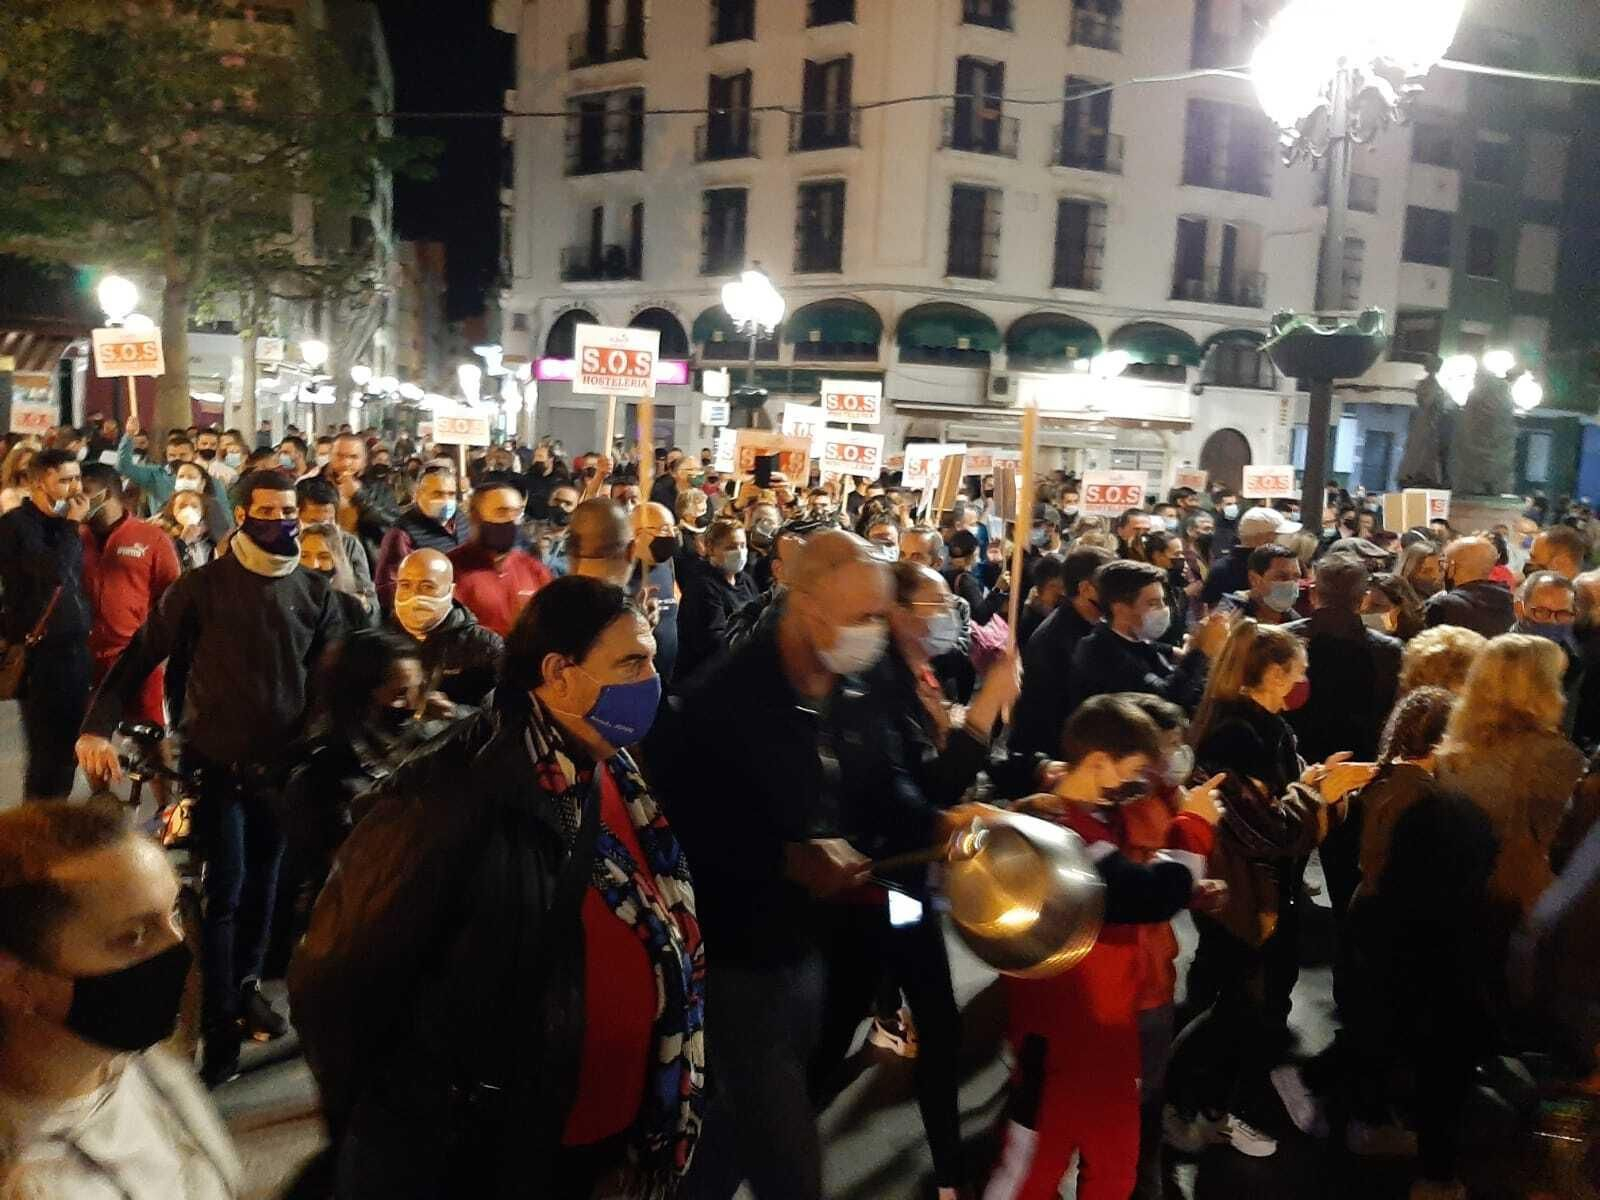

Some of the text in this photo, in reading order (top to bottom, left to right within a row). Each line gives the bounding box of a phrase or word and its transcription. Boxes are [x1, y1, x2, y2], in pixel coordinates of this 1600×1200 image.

[101, 342, 157, 361] S.O.S
[583, 347, 651, 377] S.O.S
[827, 394, 875, 412] S.O.S
[826, 443, 876, 464] S.O.S
[1247, 476, 1289, 490] S.O.S
[1086, 485, 1140, 504] S.O.S
